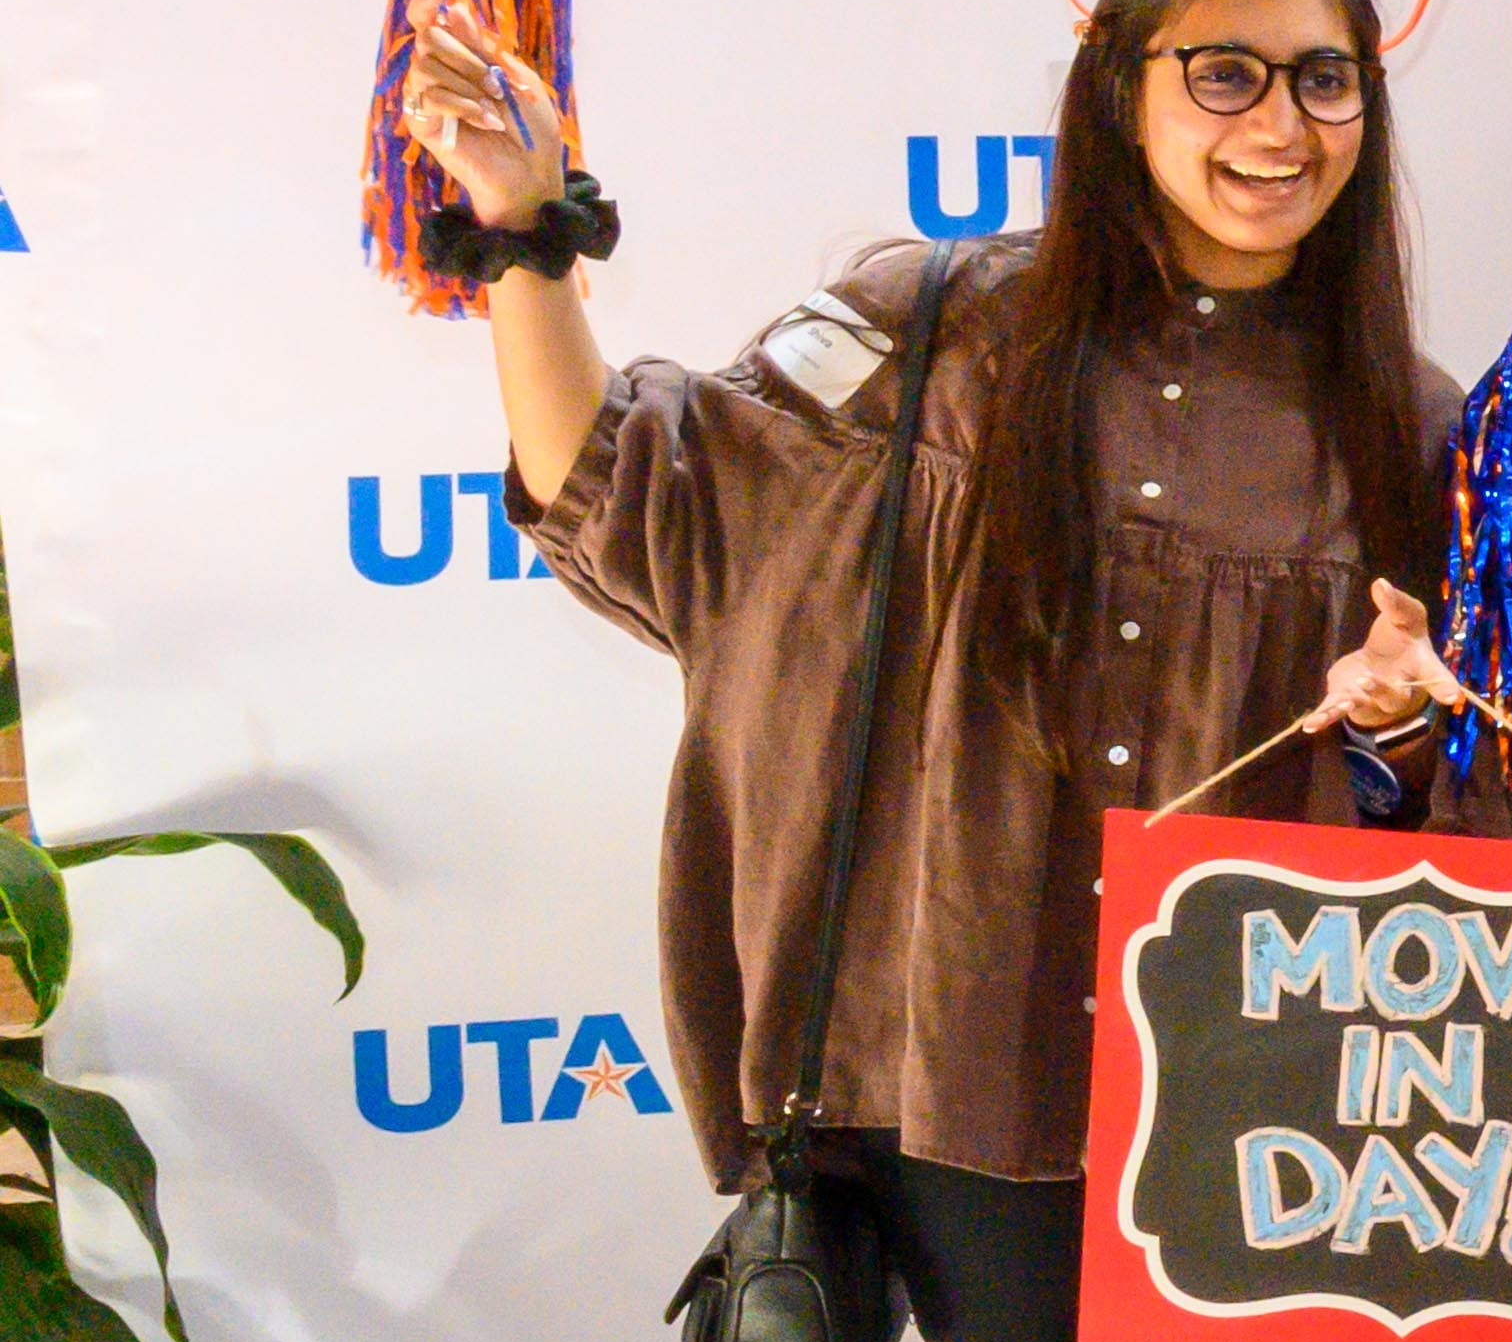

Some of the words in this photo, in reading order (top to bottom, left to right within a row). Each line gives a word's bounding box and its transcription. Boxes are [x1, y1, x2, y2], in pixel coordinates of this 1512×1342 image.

[348, 471, 556, 587] UT
[353, 1013, 674, 1134] UTA
[1336, 1020, 1485, 1127] IN
